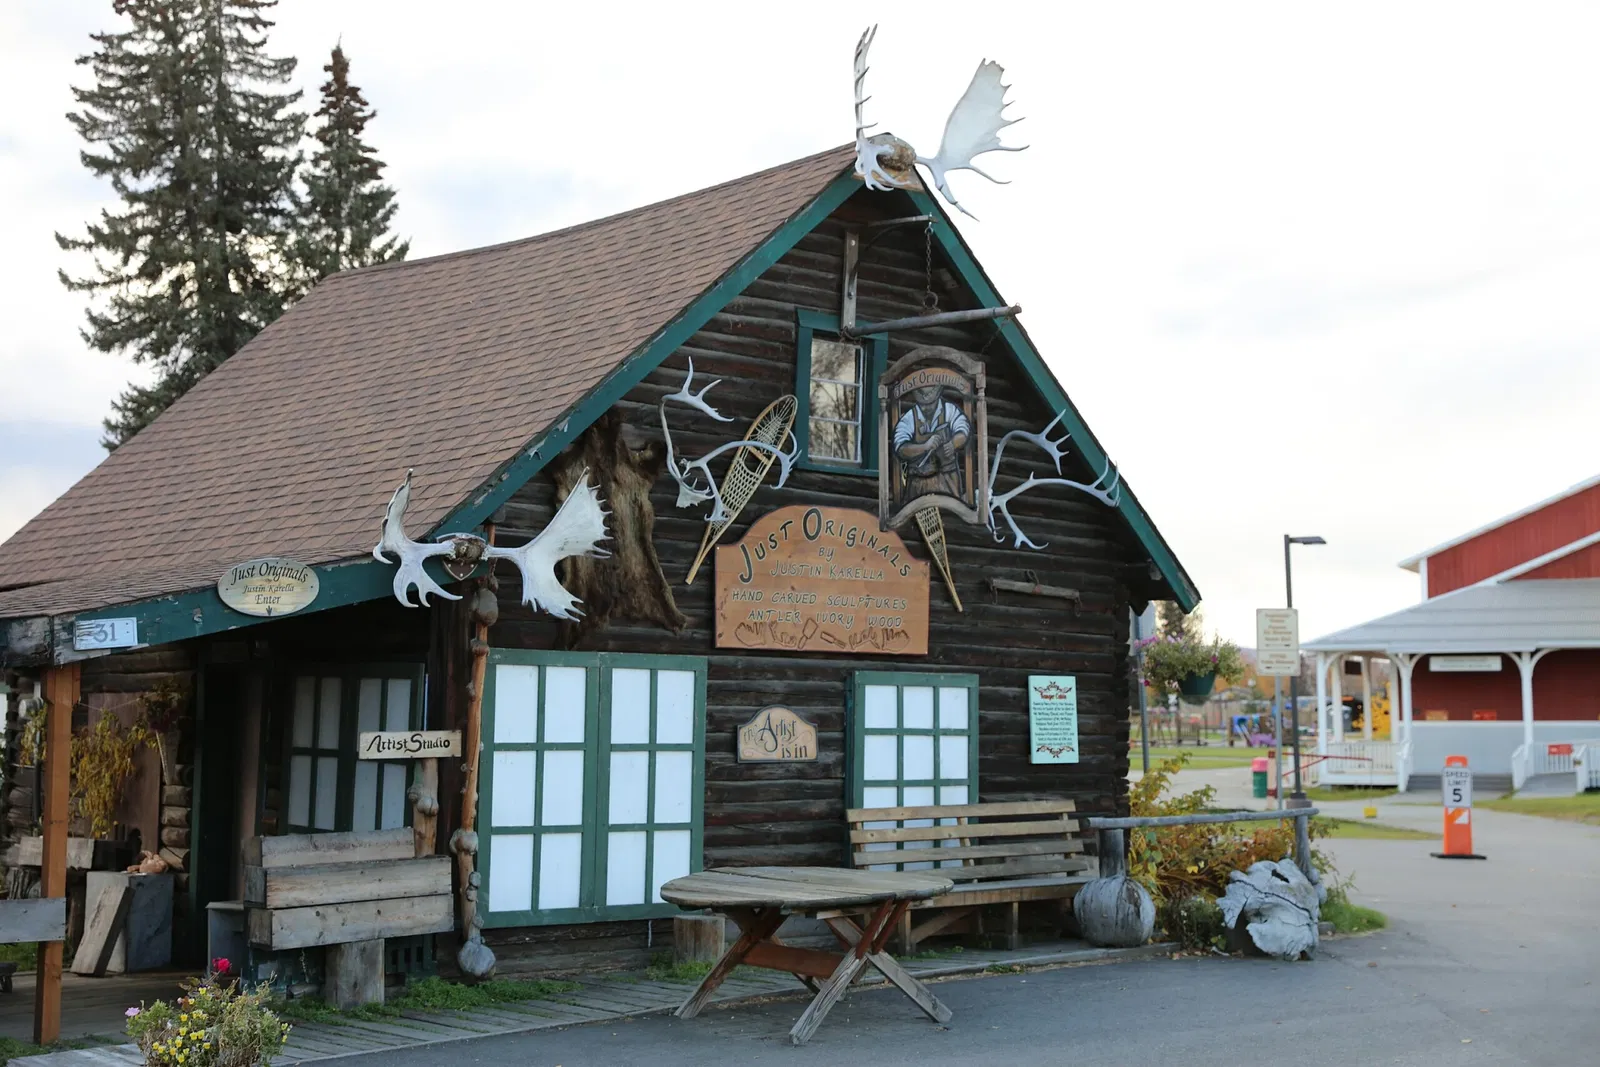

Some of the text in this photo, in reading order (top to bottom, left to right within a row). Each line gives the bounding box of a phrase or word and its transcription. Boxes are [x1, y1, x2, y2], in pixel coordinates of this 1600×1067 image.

[893, 376, 918, 398] Just
[230, 561, 309, 586] Just Originals
[770, 560, 885, 581] JUSTIN KARELLA
[242, 583, 294, 594] Justin Karella
[254, 594, 281, 604] Enter
[731, 591, 908, 610] HAND CARVED SCULPTURES
[747, 609, 802, 624] ANTLER
[868, 615, 903, 628] WOOD
[93, 622, 119, 643] 31
[758, 713, 796, 752] Artist
[366, 733, 450, 753] Artist Studio
[781, 744, 808, 758] is in
[1452, 788, 1463, 803] 5
